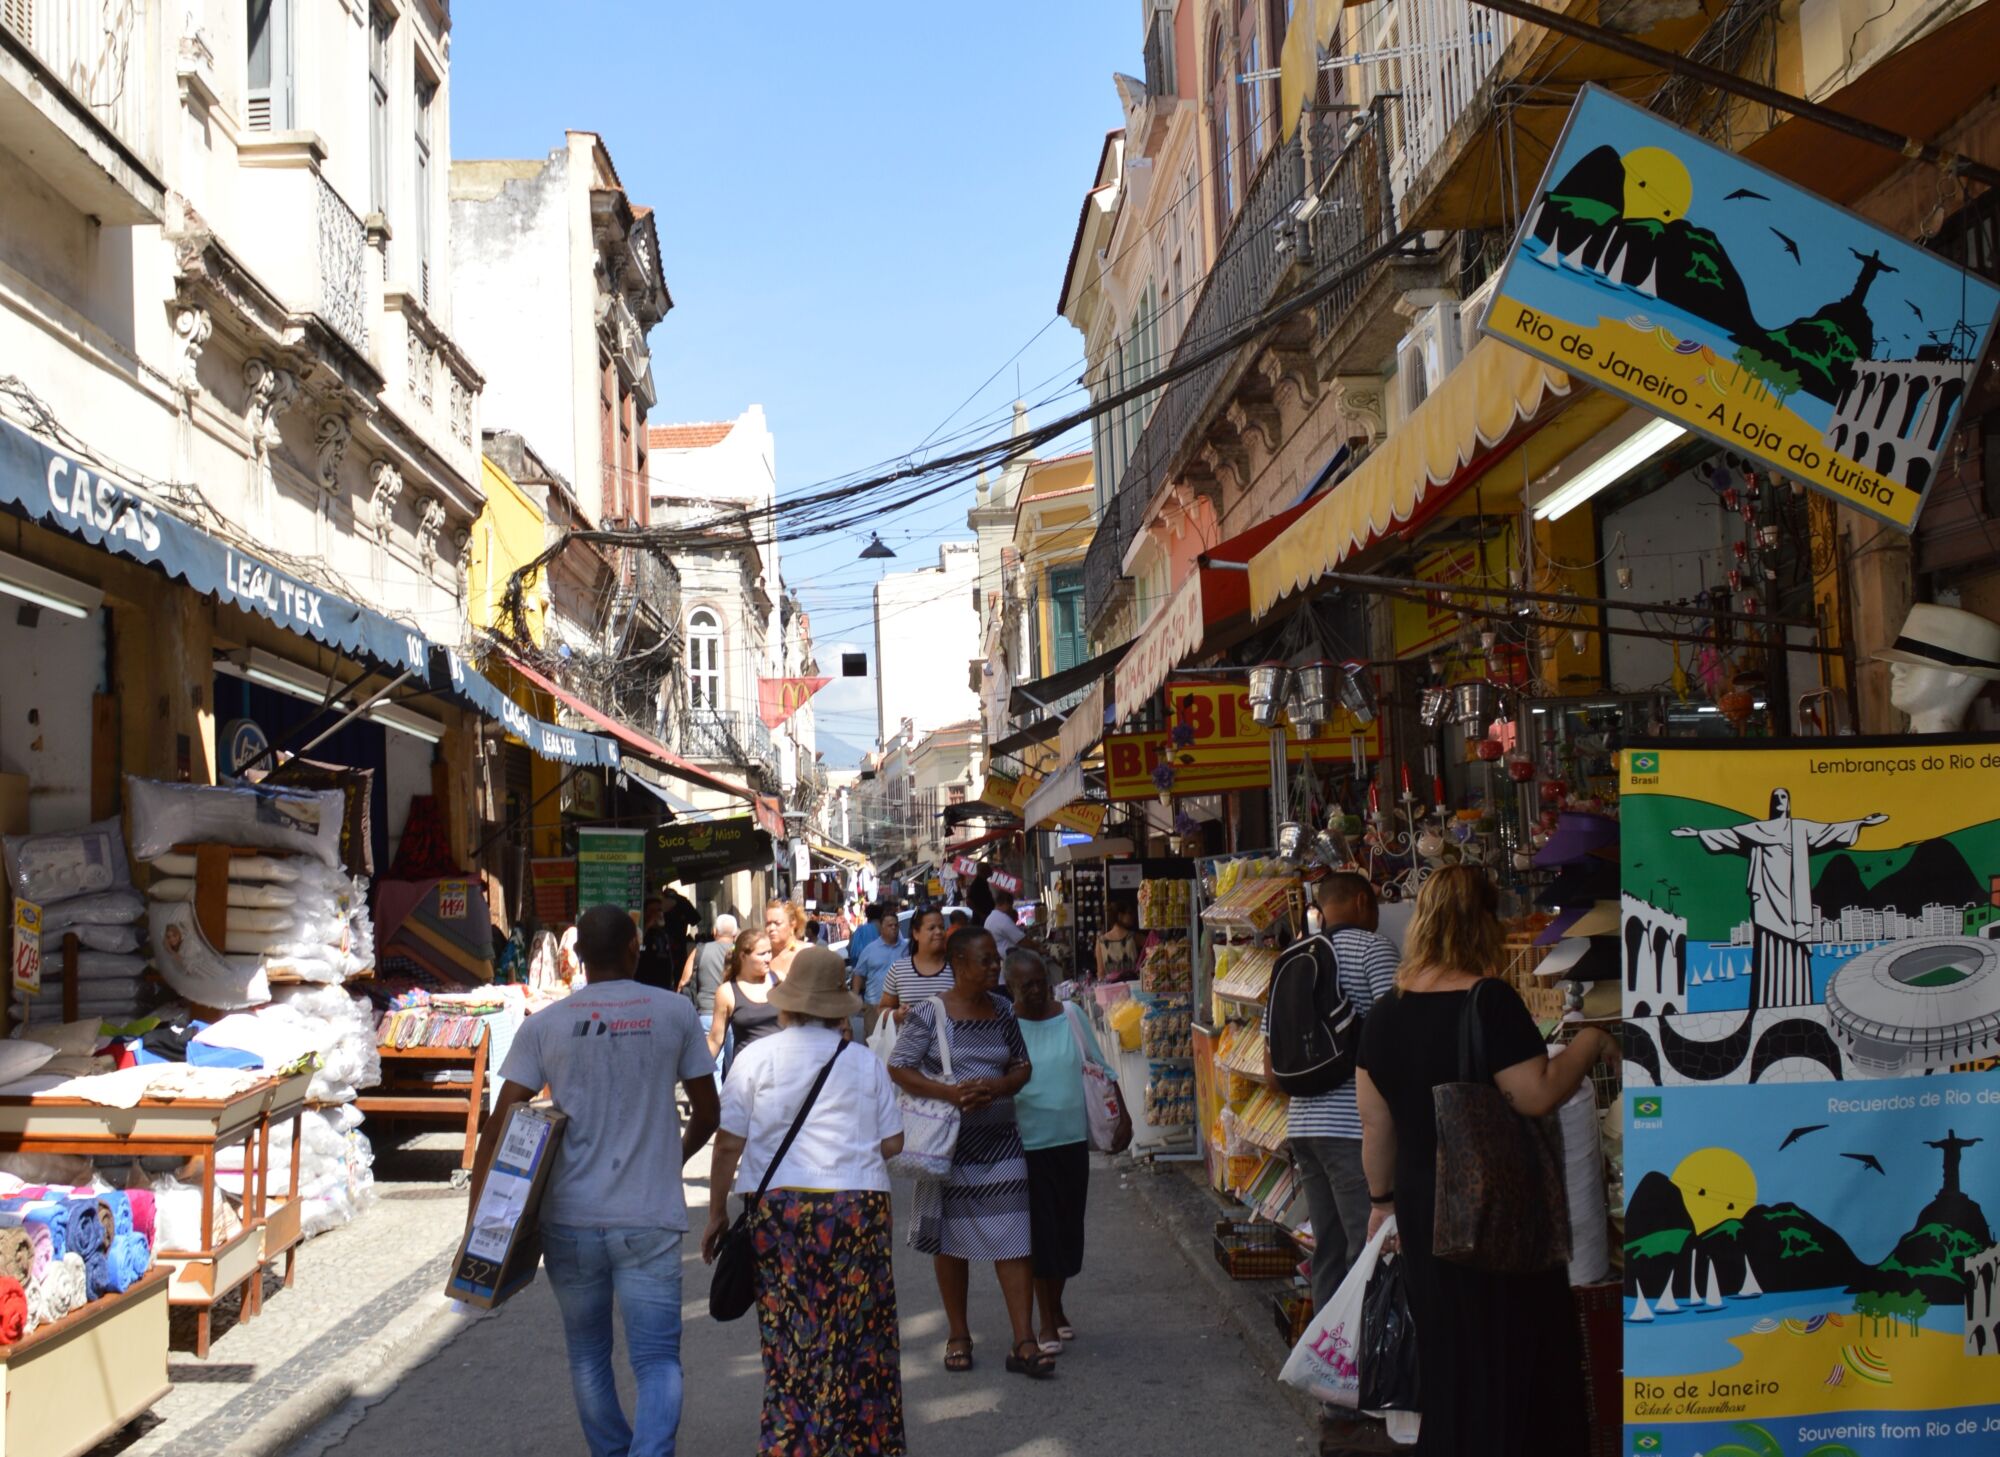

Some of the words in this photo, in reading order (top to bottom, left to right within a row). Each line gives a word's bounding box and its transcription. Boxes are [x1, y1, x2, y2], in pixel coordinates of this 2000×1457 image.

[1515, 308, 1553, 343] Rio
[1560, 330, 1593, 362] de
[1599, 349, 1689, 405] Janeiro
[1706, 404, 1728, 427] A
[1731, 415, 1783, 454] Loja
[1787, 443, 1821, 470] do
[1827, 456, 1895, 506] turista
[47, 455, 161, 552] CASAS
[1810, 755, 1917, 776] Lembranças
[1921, 754, 1945, 772] do
[1949, 753, 1975, 770] Rio
[1979, 752, 2000, 769] de
[1631, 775, 1659, 786] Brasil
[658, 835, 686, 849] Suco
[715, 828, 741, 841] Misto
[609, 1017, 652, 1032] direct
[1827, 1094, 1916, 1113] Recuerdos
[1919, 1092, 1940, 1107] de
[1945, 1088, 1971, 1105] Rio
[1976, 1088, 2000, 1104] de
[1633, 1119, 1663, 1130] Brasil
[1634, 1382, 1665, 1400] Rio
[1673, 1380, 1698, 1398] de
[1707, 1379, 1780, 1398] Janeiro
[1634, 1400, 1673, 1417] Cidade
[1676, 1400, 1747, 1416] Maravilhosa
[1798, 1422, 1876, 1442] Souvenirs
[1881, 1422, 1921, 1439] from
[1926, 1421, 1951, 1437] Rio
[1955, 1419, 1978, 1434] de
